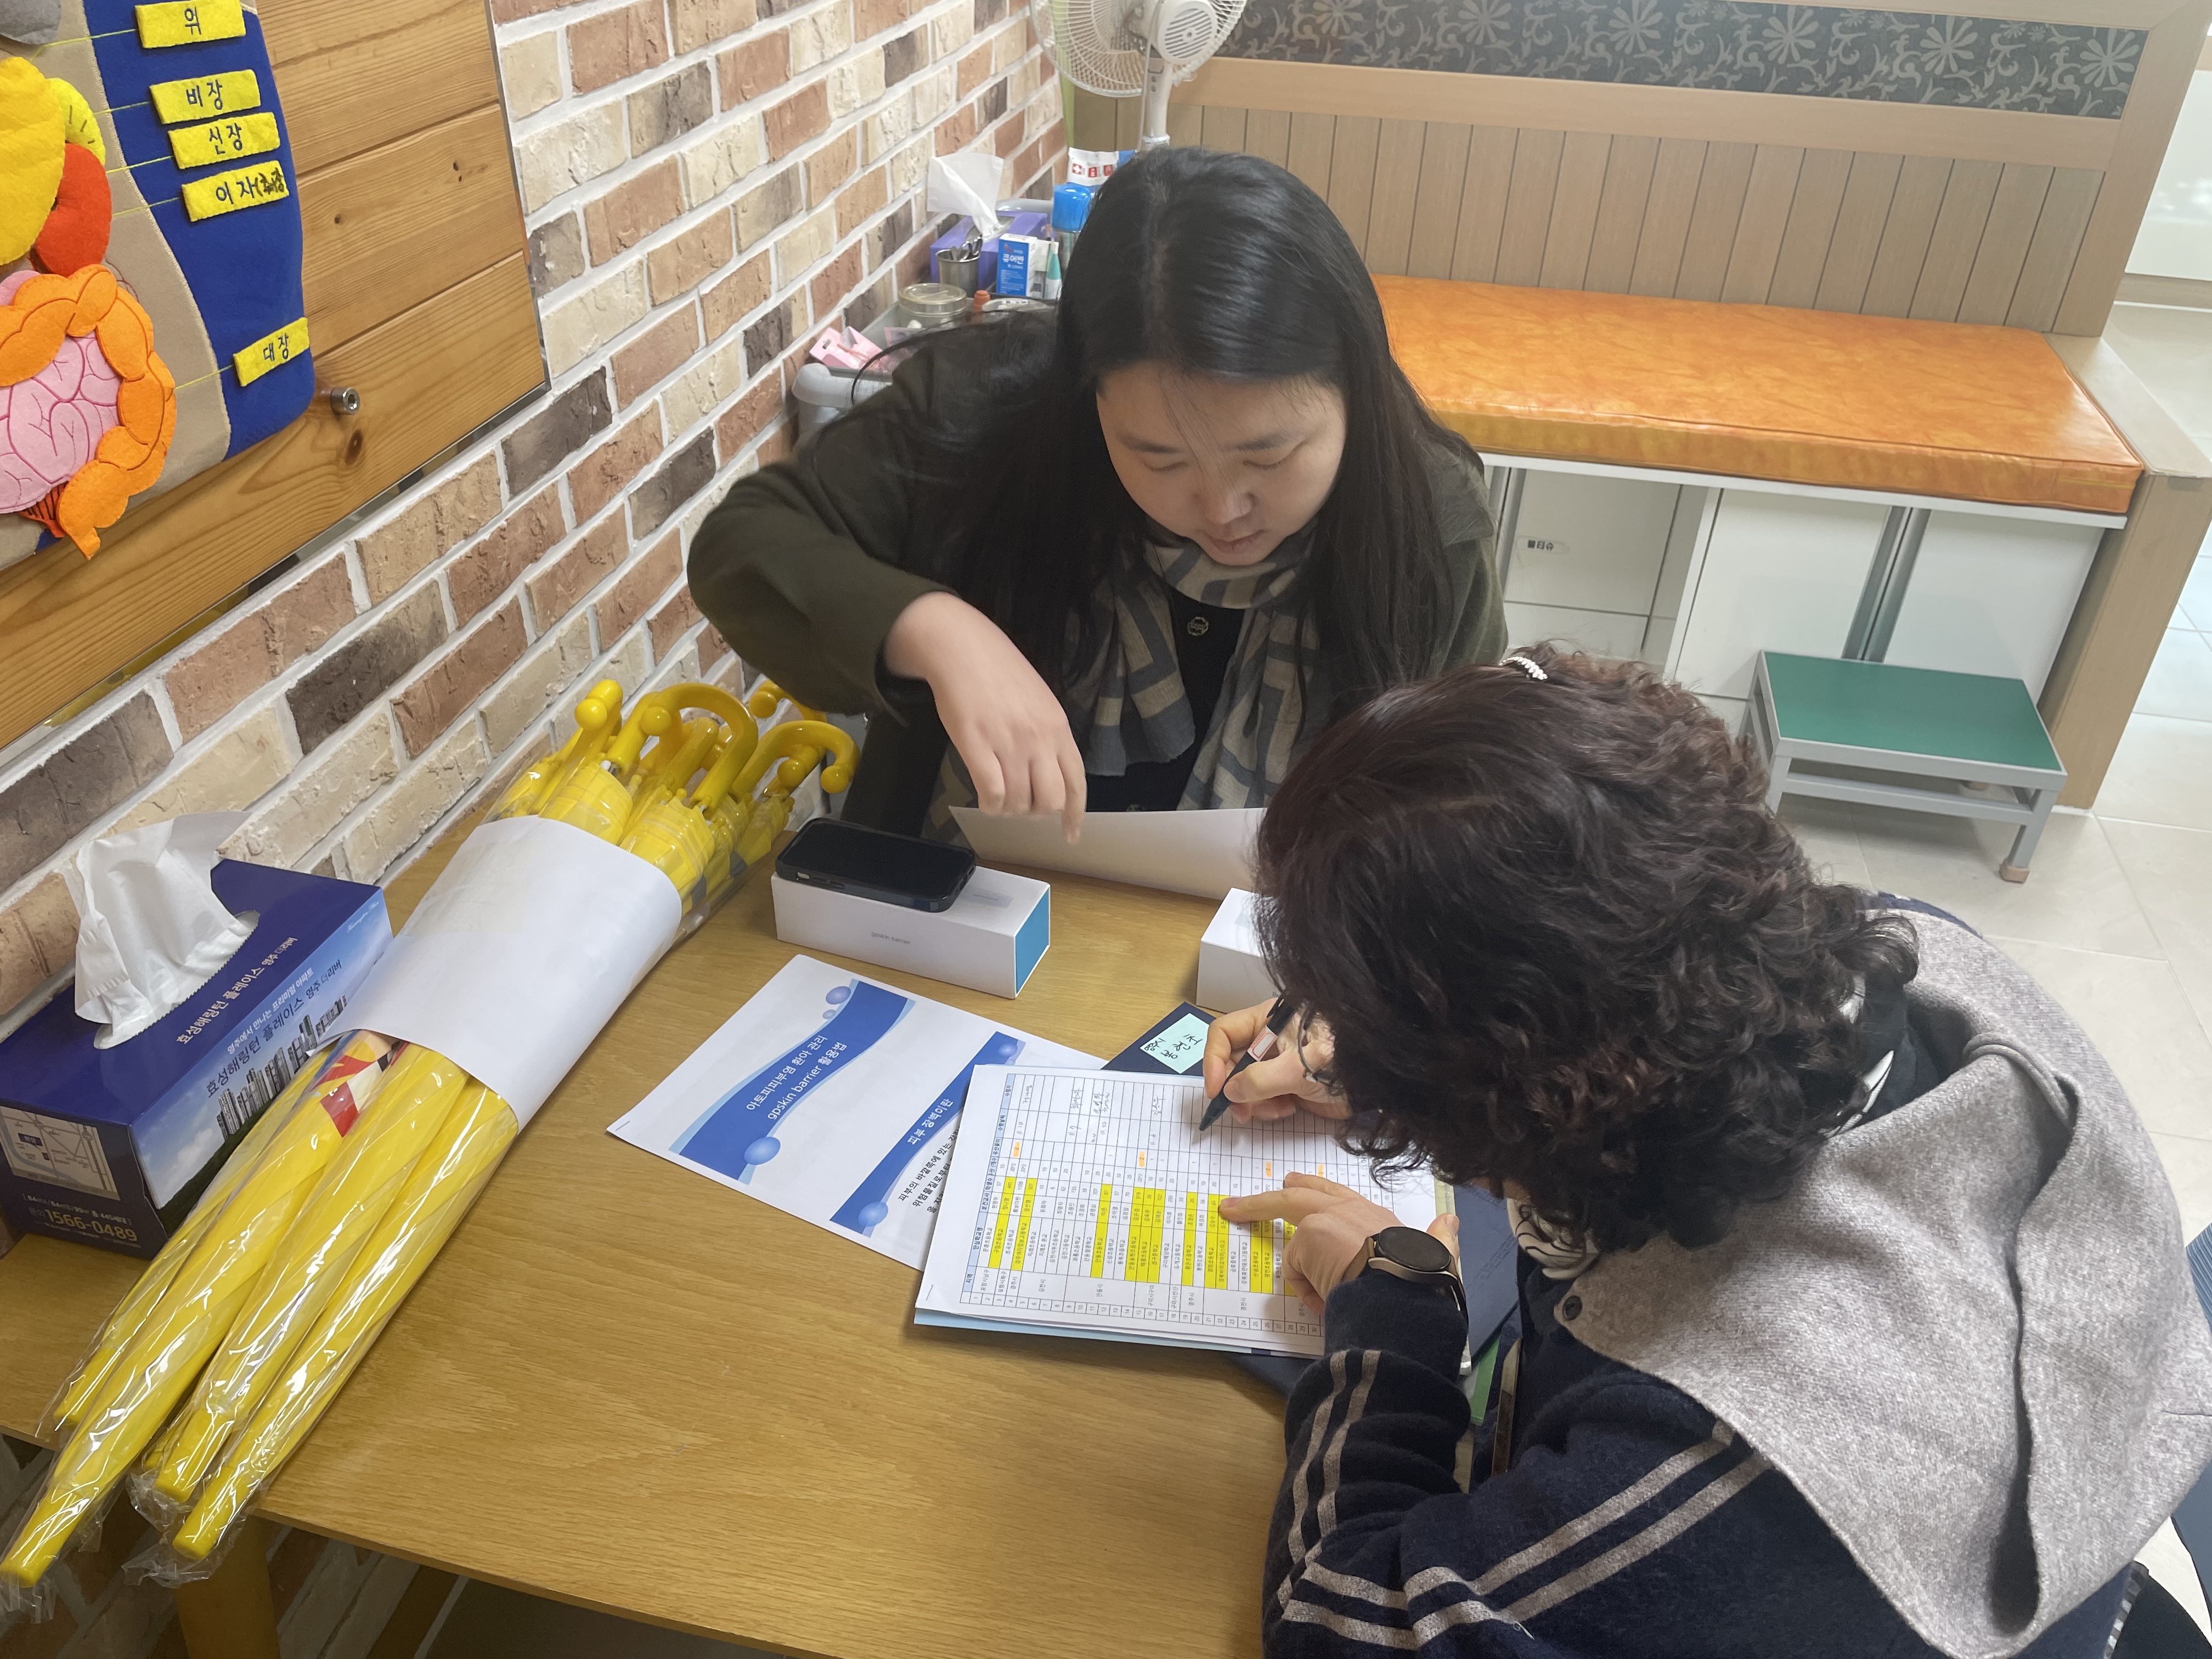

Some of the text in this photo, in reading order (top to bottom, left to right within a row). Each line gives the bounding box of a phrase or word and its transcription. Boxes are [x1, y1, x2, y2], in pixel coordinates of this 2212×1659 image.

[184, 7, 201, 35] 위
[186, 79, 223, 110] 비장
[209, 123, 242, 155] 신장
[263, 333, 289, 362] 대장
[891, 936, 910, 945] barrier
[176, 936, 298, 1045] 효성해링턴 플레이스 영주 더리버
[227, 967, 314, 1054] 영주에서 만나는 프리미엄 아파트
[206, 960, 342, 1098] 효성해링턴 플레이스 영주 더리버
[747, 1035, 828, 1110] 아토피피부염 환아 관리
[768, 1042, 848, 1120] gpskin barrier 활용법
[907, 1098, 953, 1145] 피부 장벽이란
[898, 1181, 919, 1201] 피부의
[916, 1155, 941, 1181] 바깥쪽에
[937, 1143, 952, 1155] 있는
[981, 1193, 990, 1210] 보건교사
[45, 1209, 137, 1242] 1566-0489
[973, 1227, 983, 1249] 안심학교명
[966, 1273, 973, 1283] 지역
